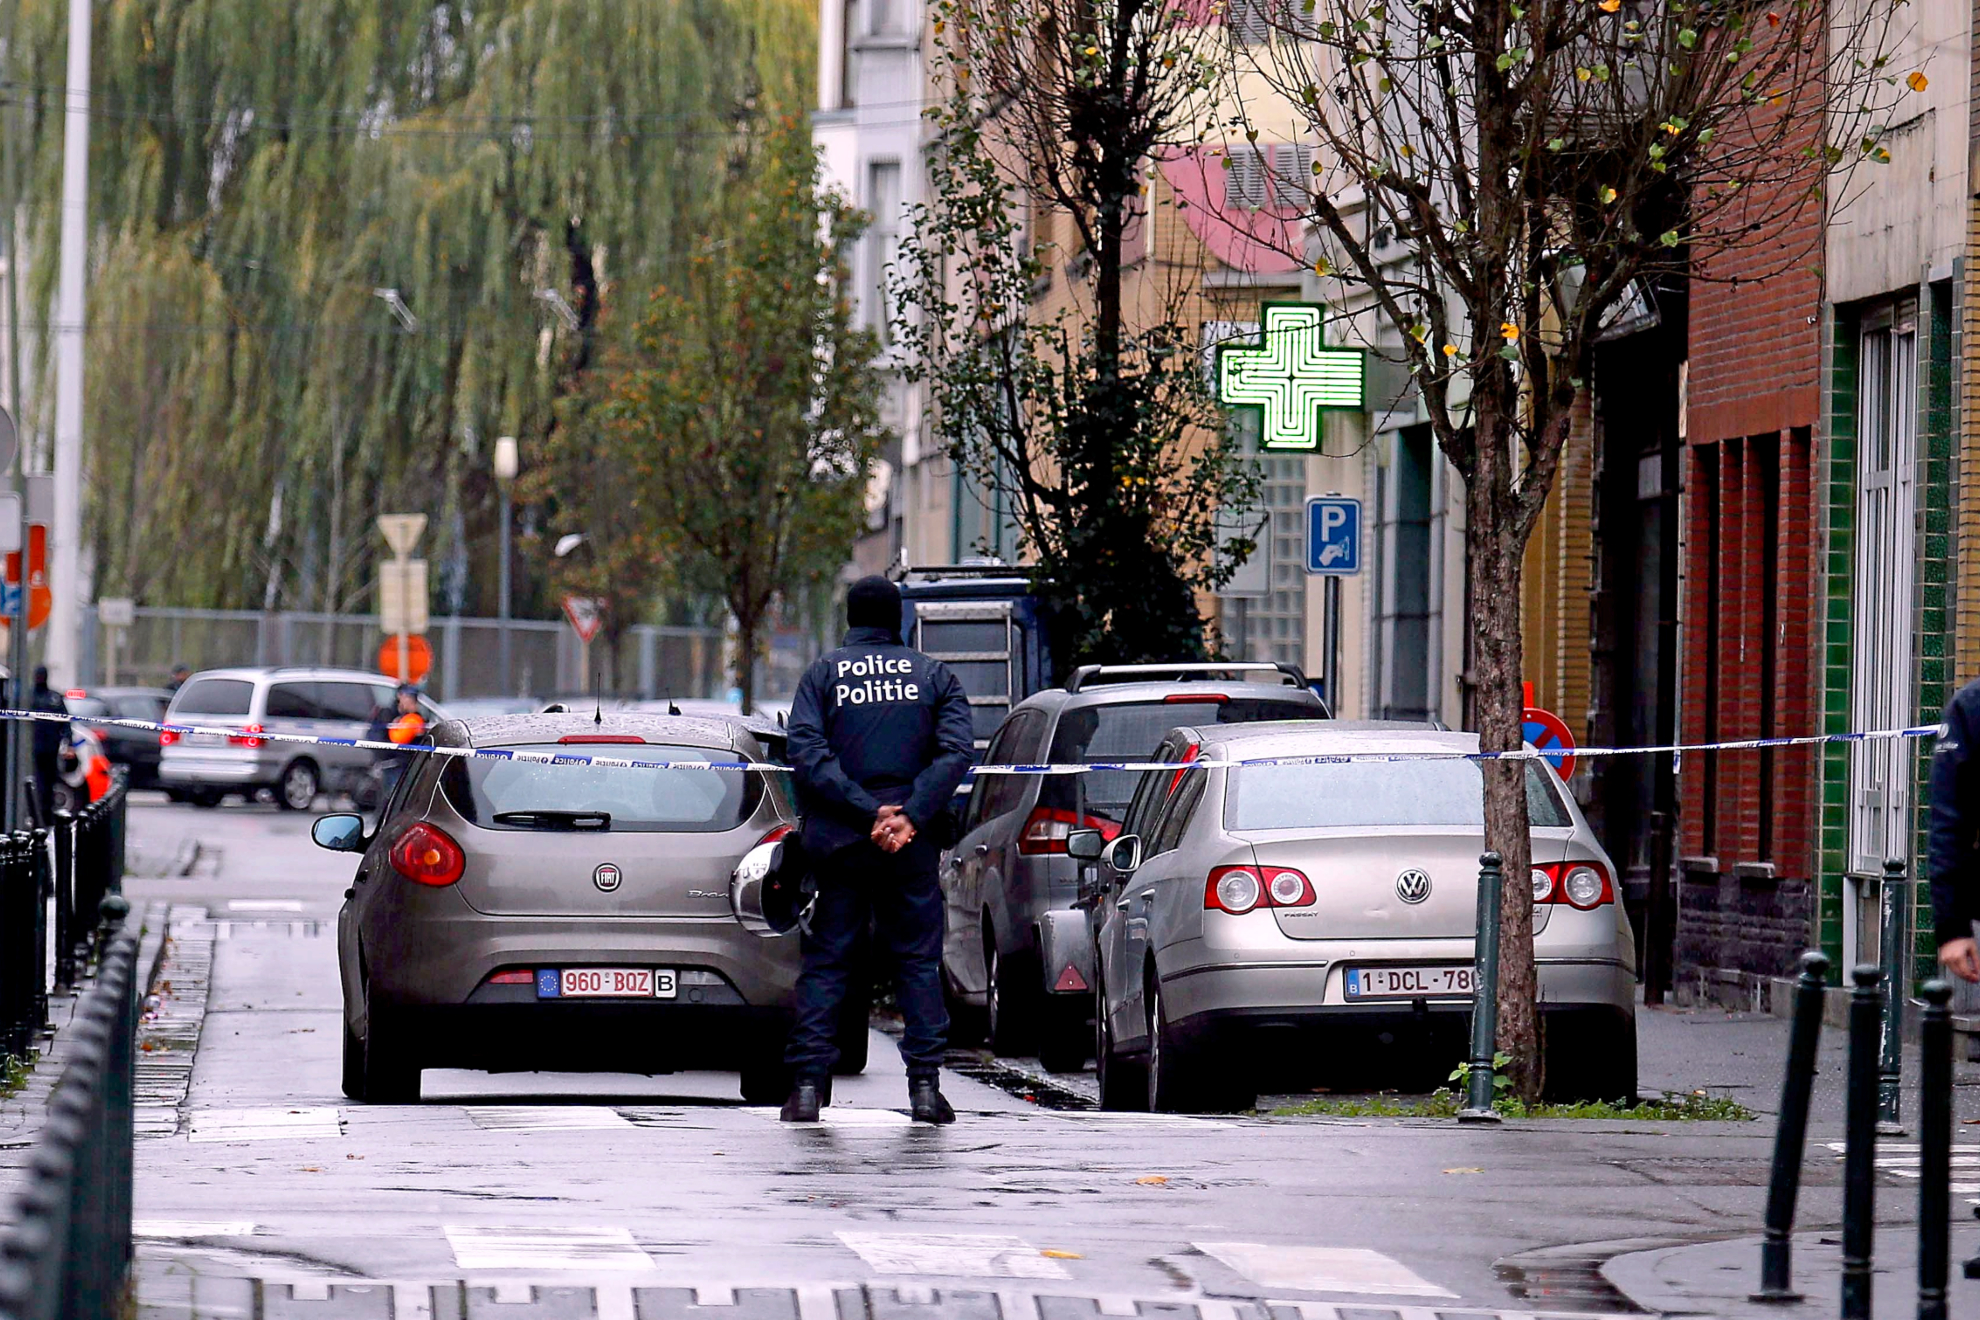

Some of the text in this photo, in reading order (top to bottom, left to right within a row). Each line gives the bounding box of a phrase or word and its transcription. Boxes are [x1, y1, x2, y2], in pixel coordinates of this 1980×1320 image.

[1321, 505, 1347, 542] P
[837, 654, 912, 678] Police
[835, 678, 919, 707] Politie
[600, 871, 616, 884] FIAT
[565, 972, 674, 992] 960-BQZ B
[1349, 984, 1358, 994] B
[1362, 969, 1475, 992] 1-DCL-78
